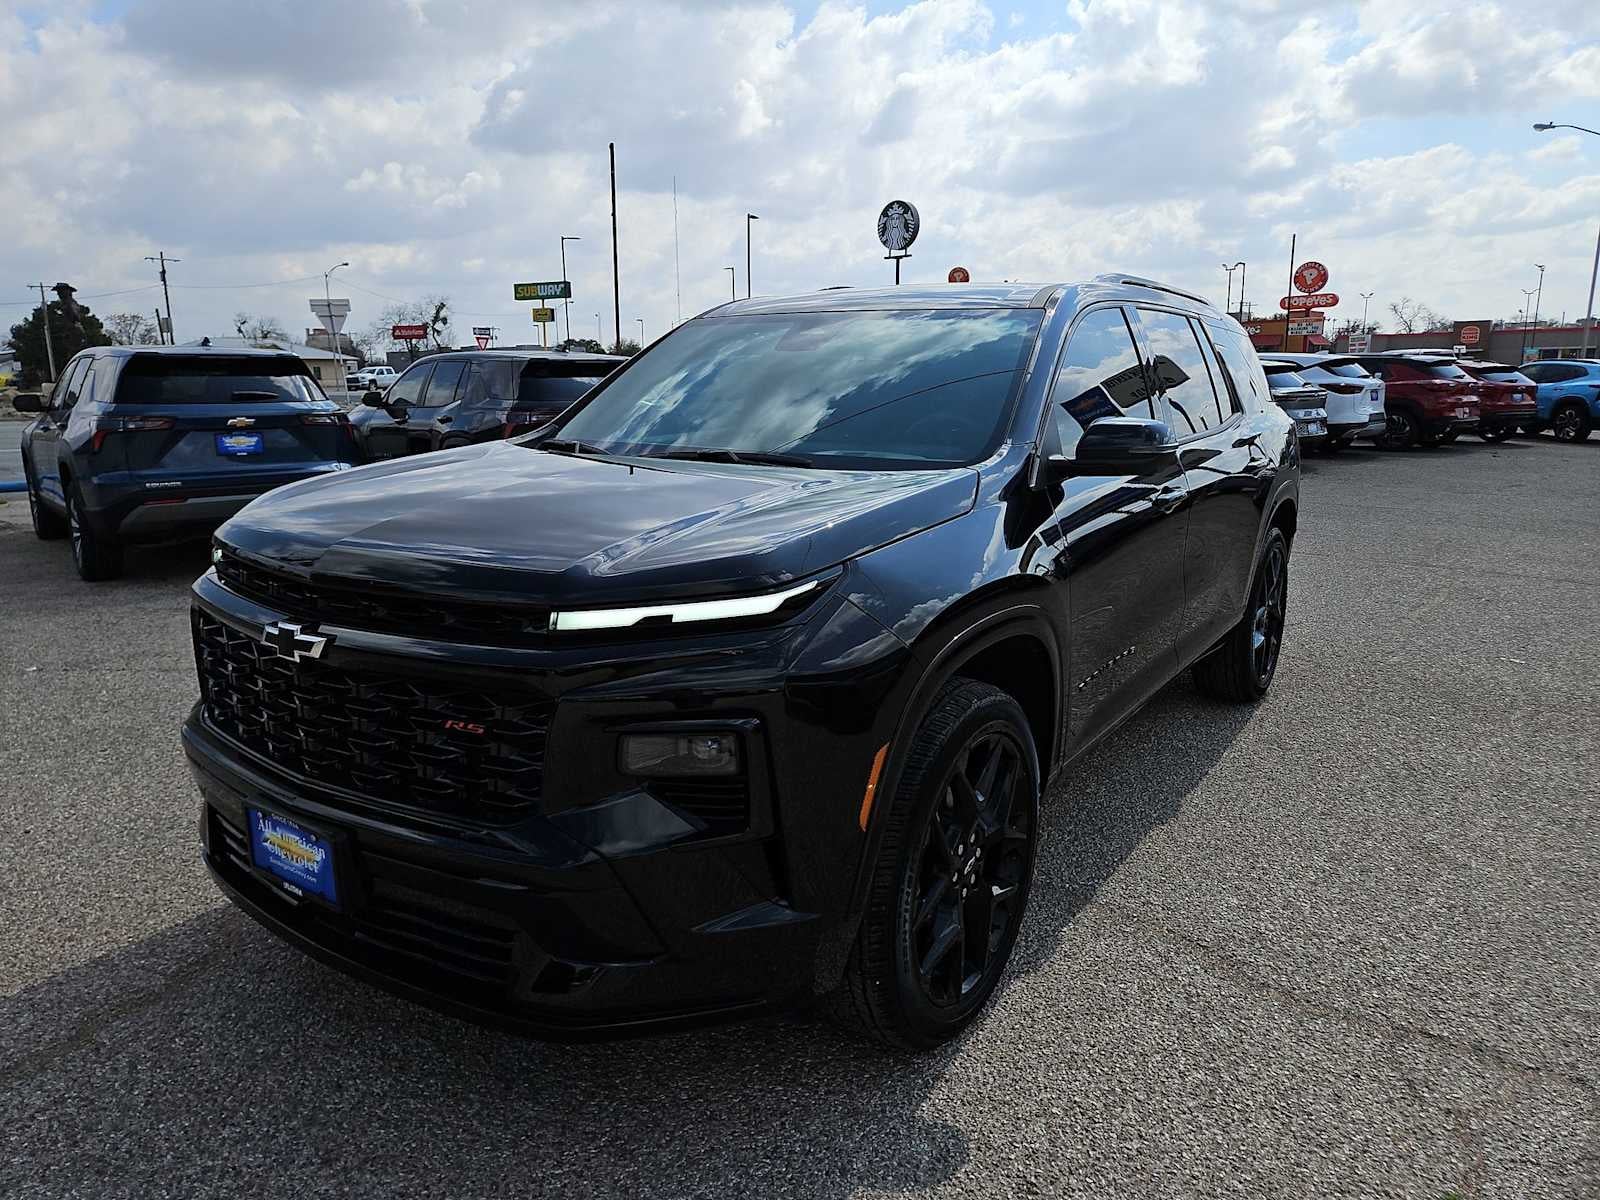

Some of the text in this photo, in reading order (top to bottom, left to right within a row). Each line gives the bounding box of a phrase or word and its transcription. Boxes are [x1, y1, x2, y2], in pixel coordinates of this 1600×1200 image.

[517, 284, 562, 298] SUBWAY
[444, 720, 485, 735] RS
[262, 840, 320, 873] Chevrolet
